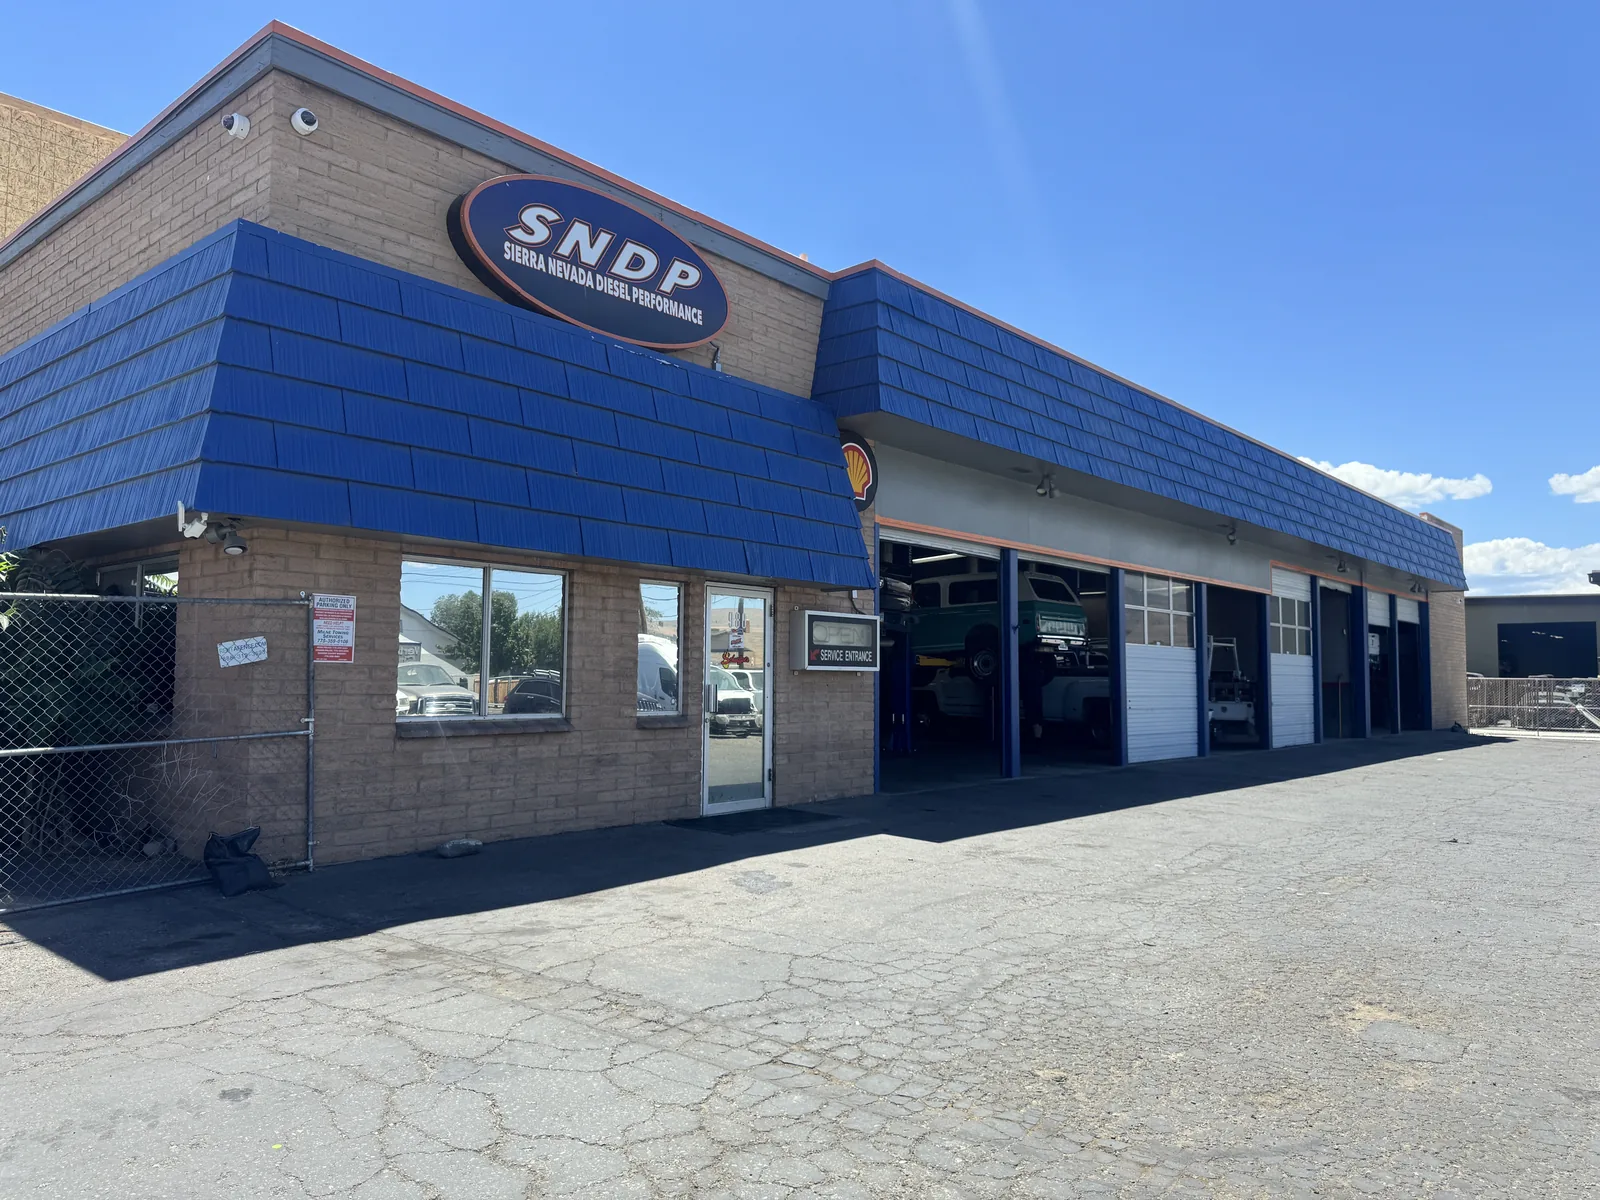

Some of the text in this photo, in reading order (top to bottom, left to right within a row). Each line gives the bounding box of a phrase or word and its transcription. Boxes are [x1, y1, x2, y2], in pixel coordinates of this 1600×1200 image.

[503, 203, 702, 296] SNDP
[503, 241, 703, 326] SIERRA NEVADA DIESEL PERFORMANCE
[820, 649, 873, 662] SERVICE ENTRANCE
